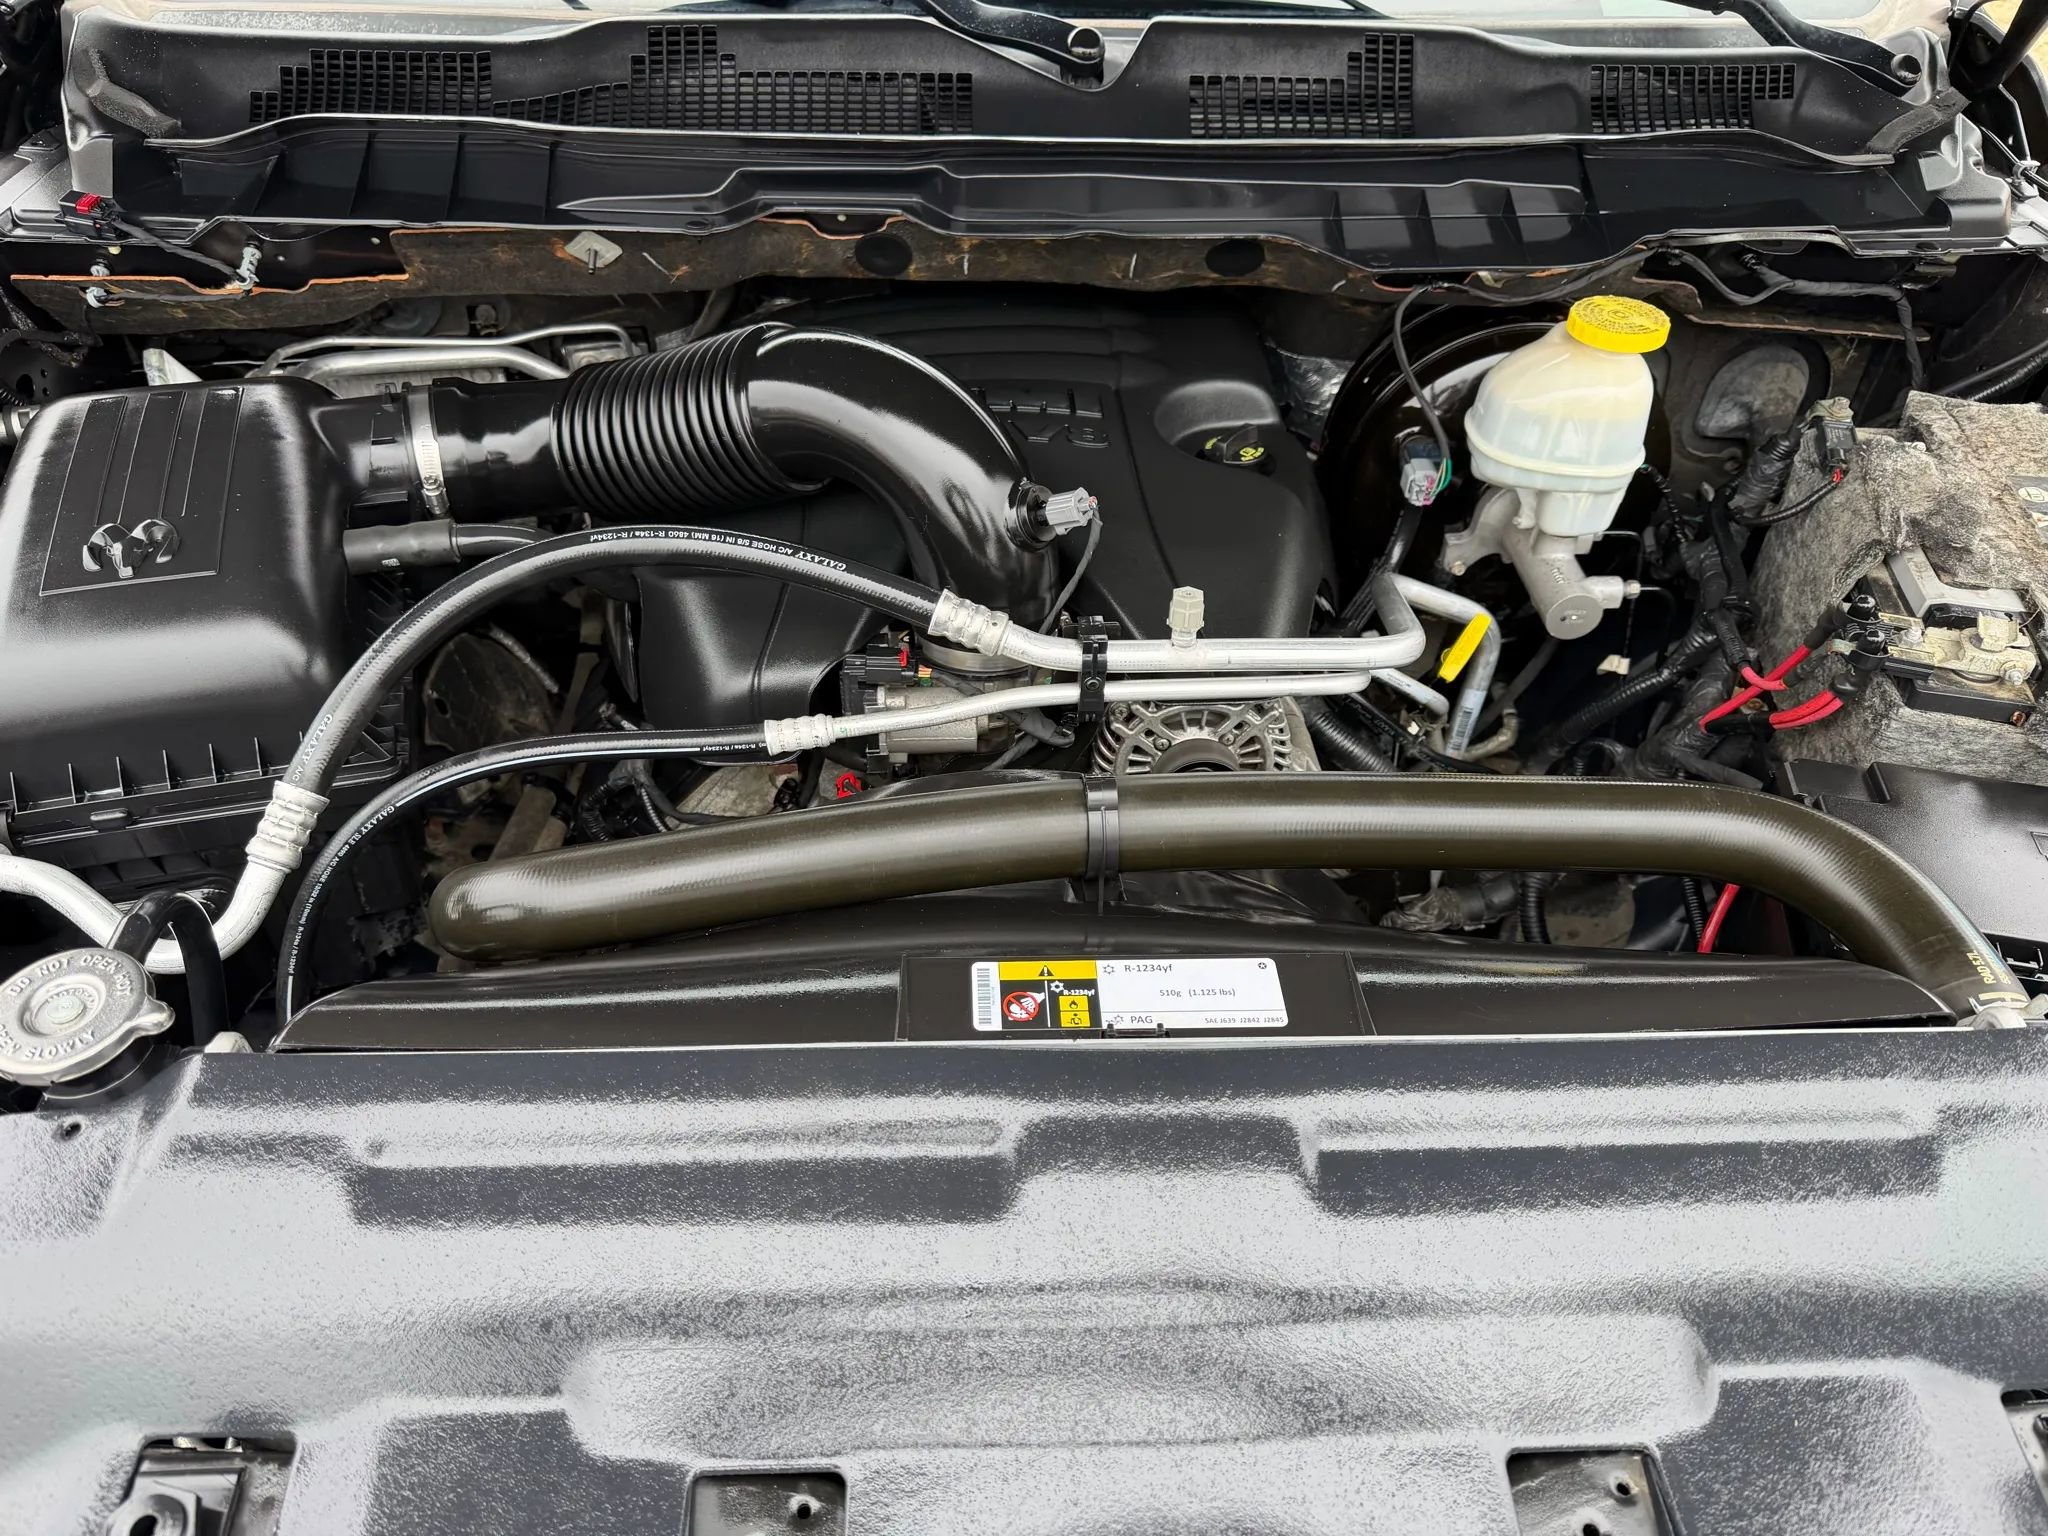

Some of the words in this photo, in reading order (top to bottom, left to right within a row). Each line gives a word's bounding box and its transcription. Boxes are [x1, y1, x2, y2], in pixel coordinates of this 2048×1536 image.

[590, 531, 628, 542] R-1234yf
[691, 532, 709, 540] MM)
[711, 534, 724, 542] (16
[726, 536, 735, 544] IN
[738, 538, 750, 546] 5/8
[752, 541, 777, 552] HOSE
[778, 546, 794, 555] A/C
[796, 551, 847, 571] GALAXY
[302, 714, 333, 764] GALAXY
[360, 805, 395, 835] GALAXY
[348, 832, 362, 845] SLE
[320, 866, 334, 883] HOSE
[1124, 964, 1173, 974] R-1234yf
[8, 975, 32, 998] DO
[35, 956, 74, 978] NOT
[80, 954, 123, 974] OPEN
[1160, 989, 1182, 998] 510g
[1188, 988, 1217, 997] (1.125
[1219, 988, 1236, 997] lbs)
[1130, 1016, 1153, 1024] PAG
[25, 1029, 96, 1061] SLOWLY
